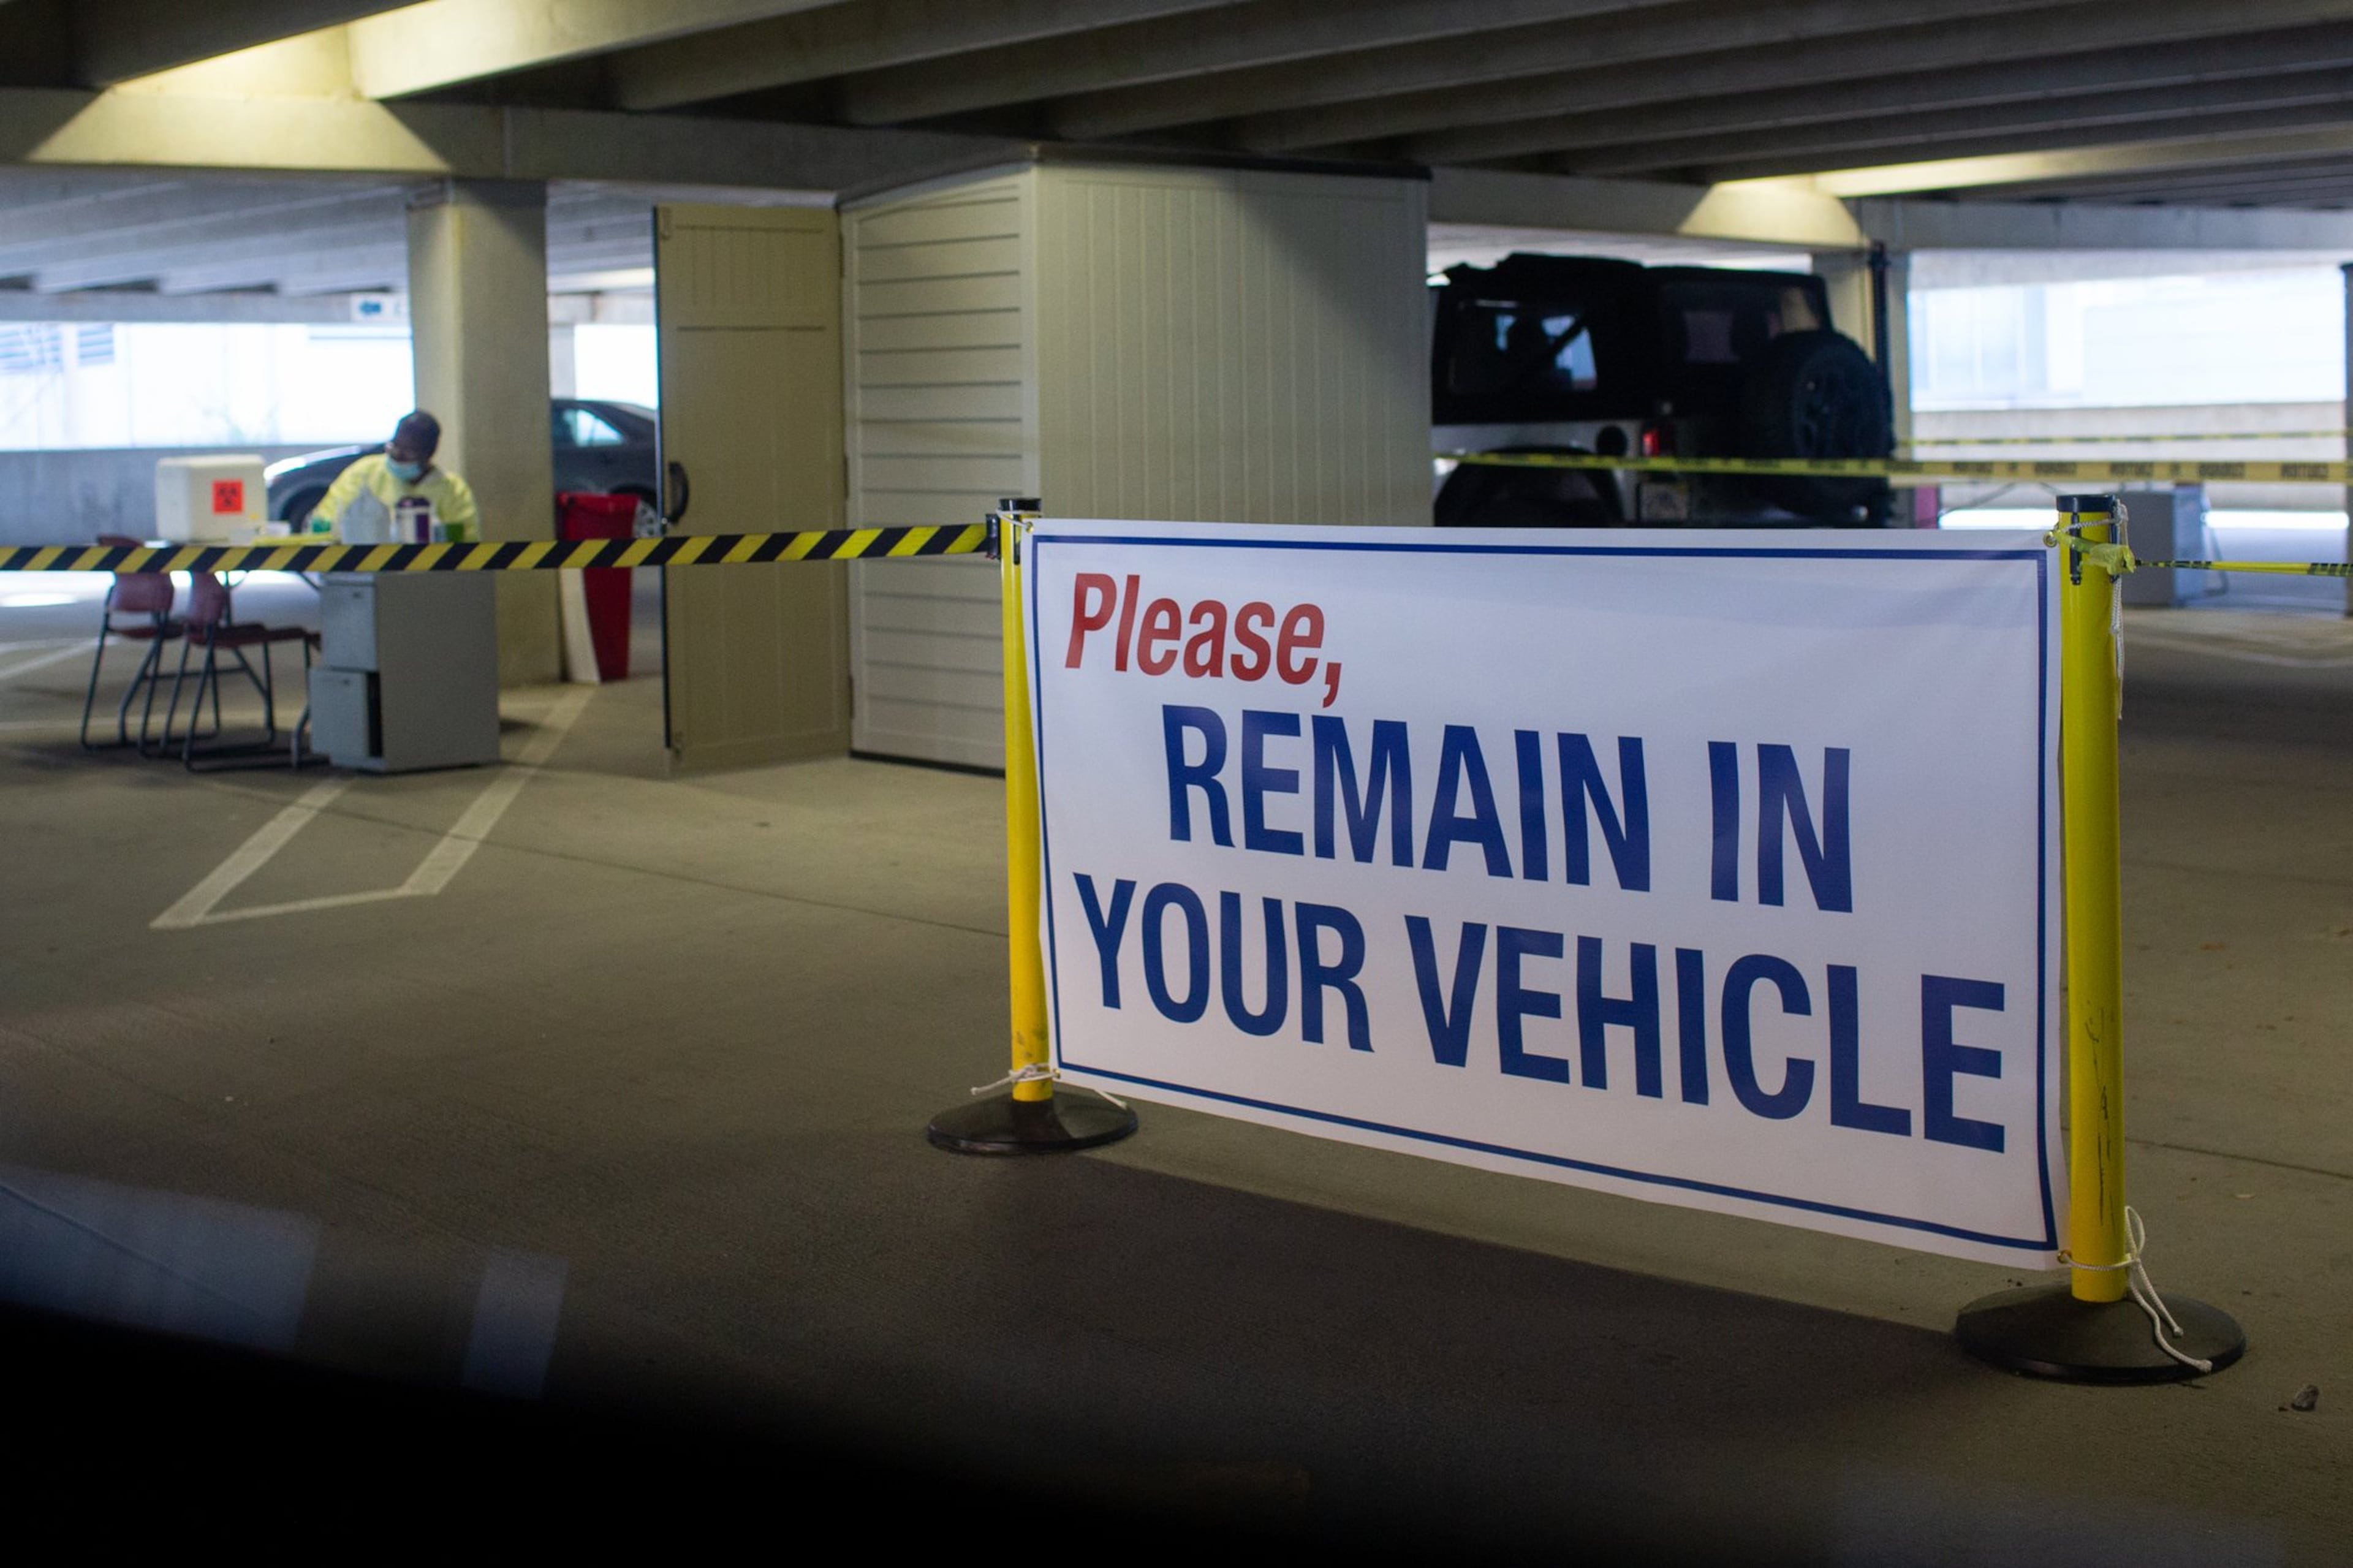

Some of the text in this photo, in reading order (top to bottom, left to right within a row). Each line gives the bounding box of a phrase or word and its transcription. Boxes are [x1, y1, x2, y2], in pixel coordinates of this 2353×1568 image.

[1066, 574, 1344, 706] Please,
[1162, 705, 1852, 913] REMAIN IN
[1074, 873, 2005, 1154] YOUR VEHICLE
